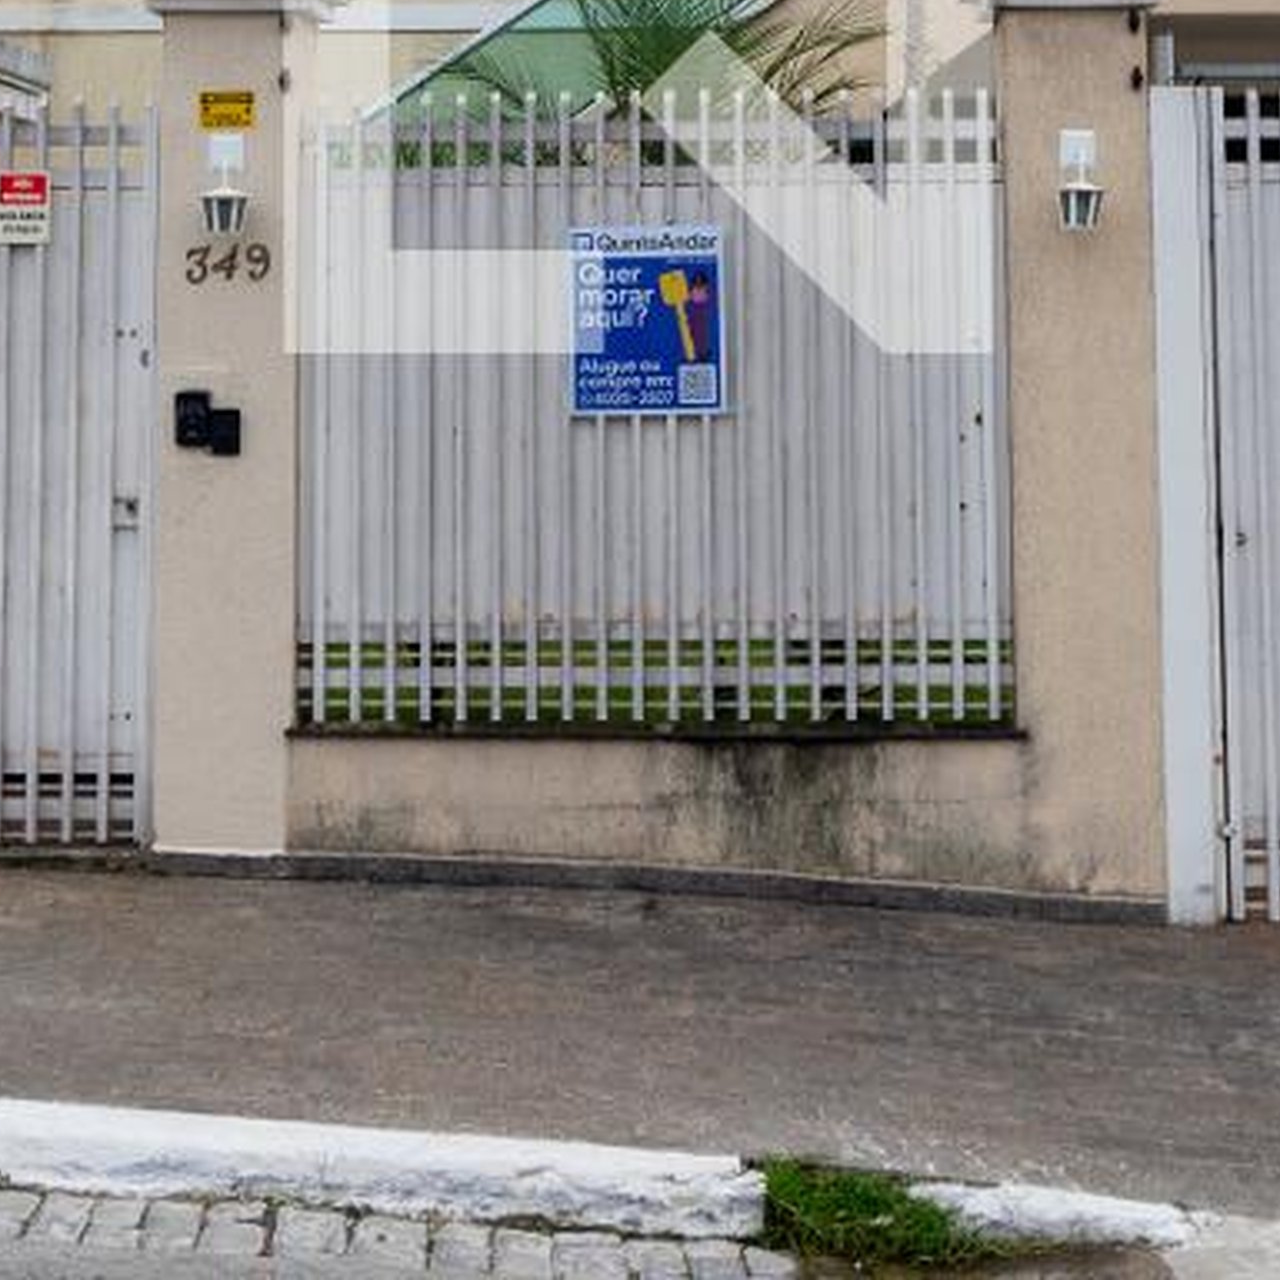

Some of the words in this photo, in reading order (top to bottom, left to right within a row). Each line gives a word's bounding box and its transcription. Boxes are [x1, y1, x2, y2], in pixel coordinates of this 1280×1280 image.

[596, 233, 718, 252] QuintoAndar
[185, 242, 271, 285] 349
[579, 262, 642, 285] Quer
[579, 288, 656, 306] morar
[579, 302, 649, 332] aqui?
[579, 357, 638, 377] Alugue
